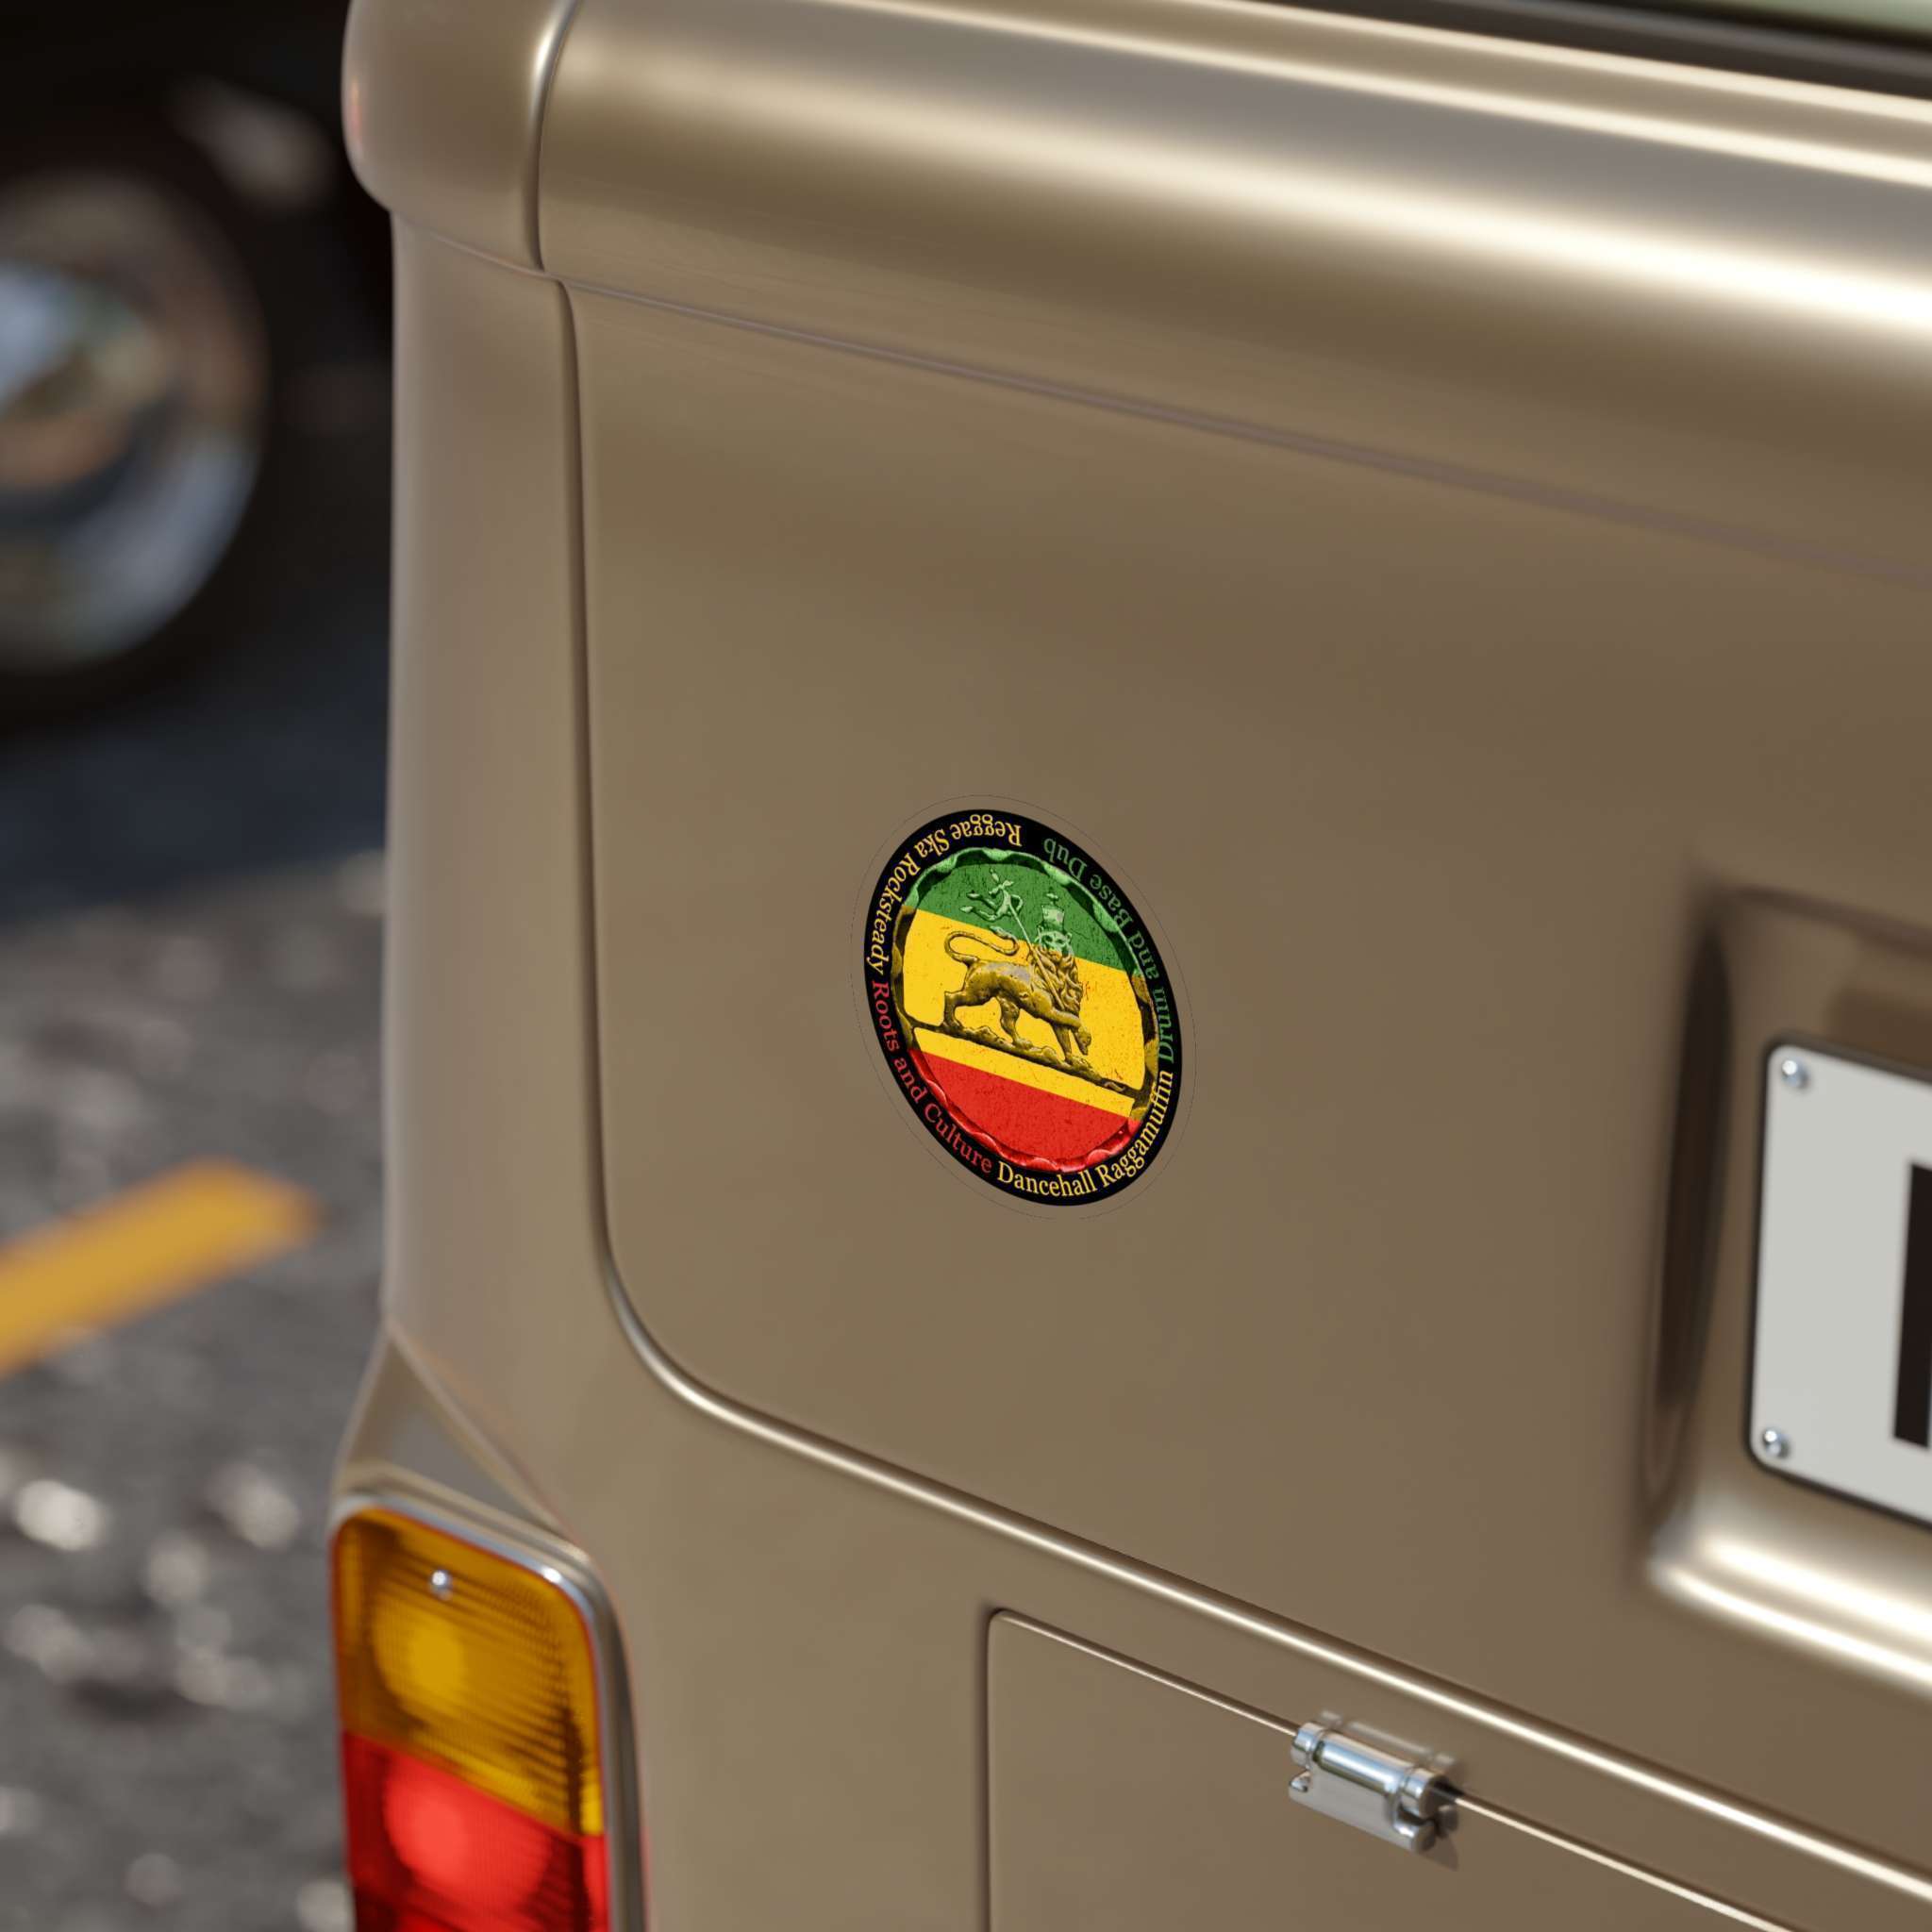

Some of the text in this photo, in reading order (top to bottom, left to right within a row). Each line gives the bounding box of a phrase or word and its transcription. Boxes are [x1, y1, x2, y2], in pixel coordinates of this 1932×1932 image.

[866, 814, 1023, 975] Reggae Ska Rocksteady
[1043, 838, 1174, 1064] Drum and Base Dub
[872, 980, 993, 1174] Roots and Culture
[997, 1070, 1174, 1197] Dancehall Raggamuffin
